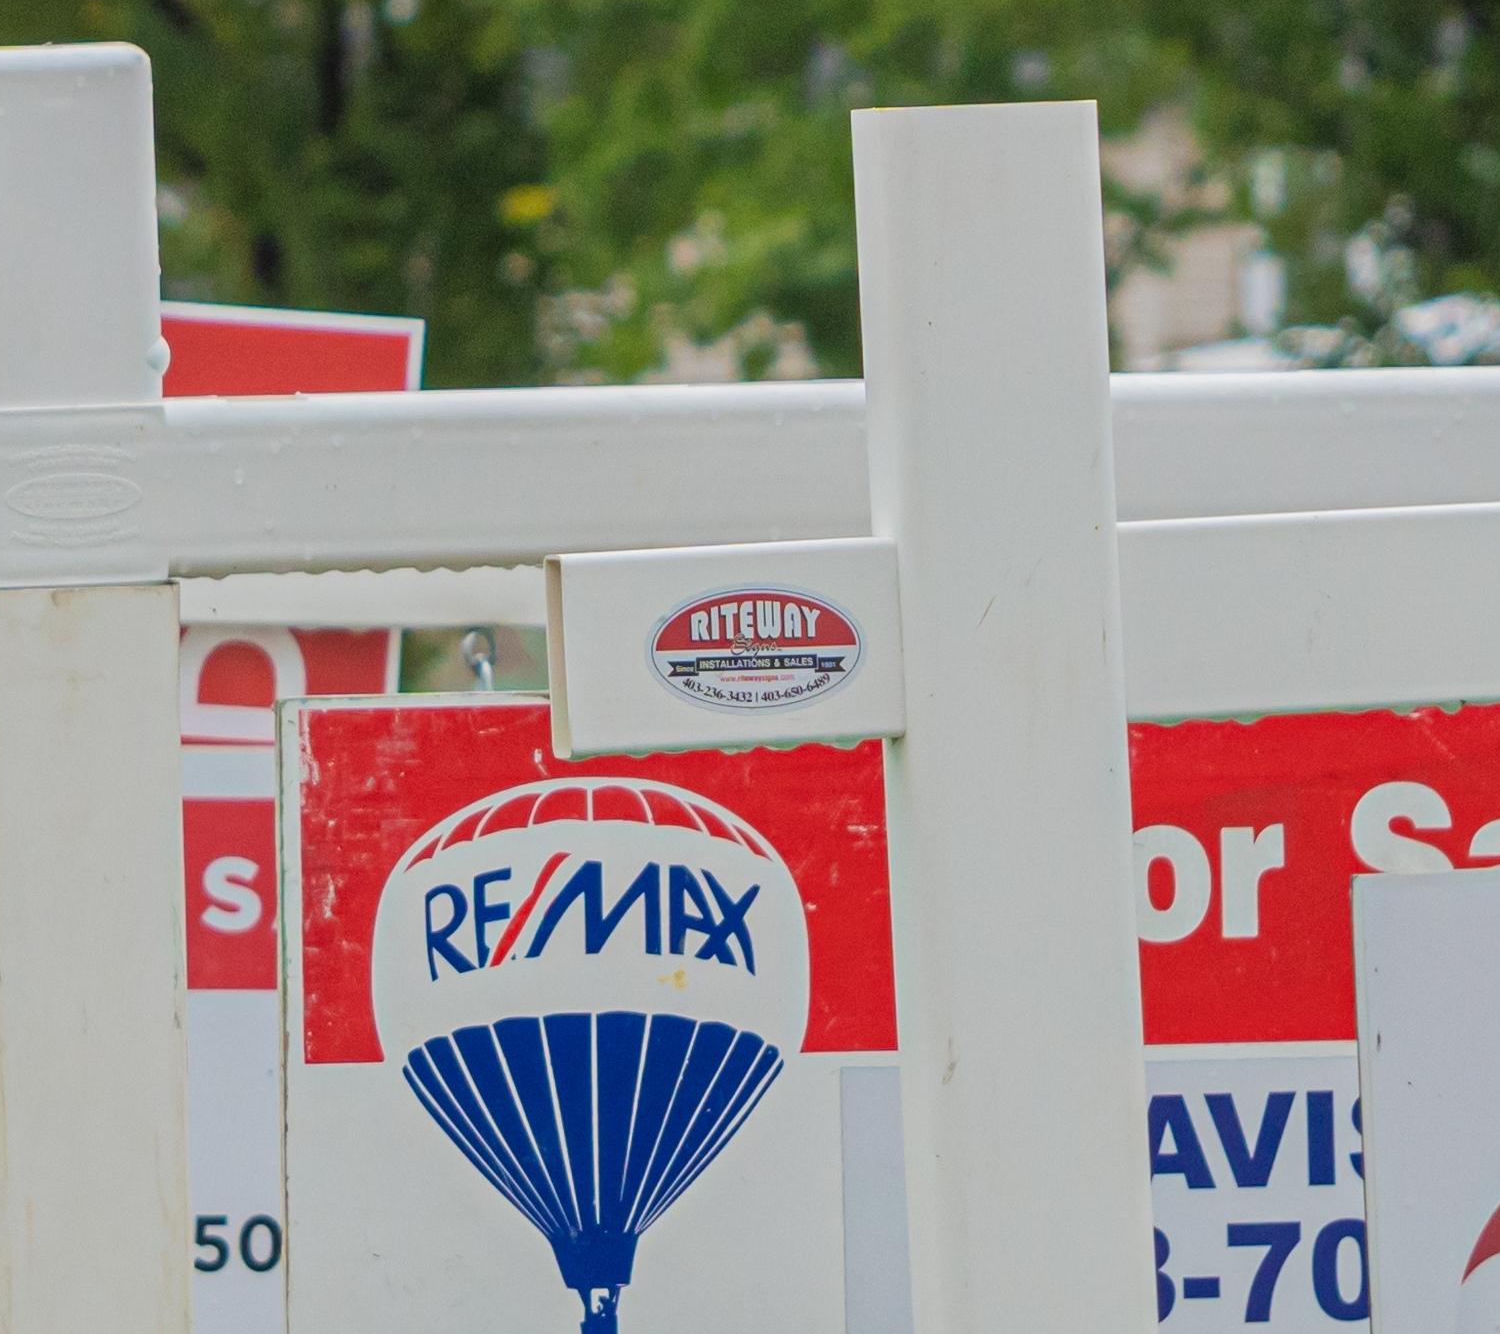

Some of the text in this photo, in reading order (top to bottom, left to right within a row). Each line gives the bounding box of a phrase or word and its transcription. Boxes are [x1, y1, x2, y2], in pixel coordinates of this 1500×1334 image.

[691, 600, 821, 641] RITEWAY
[699, 657, 771, 670] INSTALLATIONS
[783, 656, 814, 667] SALES
[682, 677, 752, 703] 403-236-3432
[761, 673, 831, 702] 403-650-6489
[424, 852, 761, 982] RE/MAX
